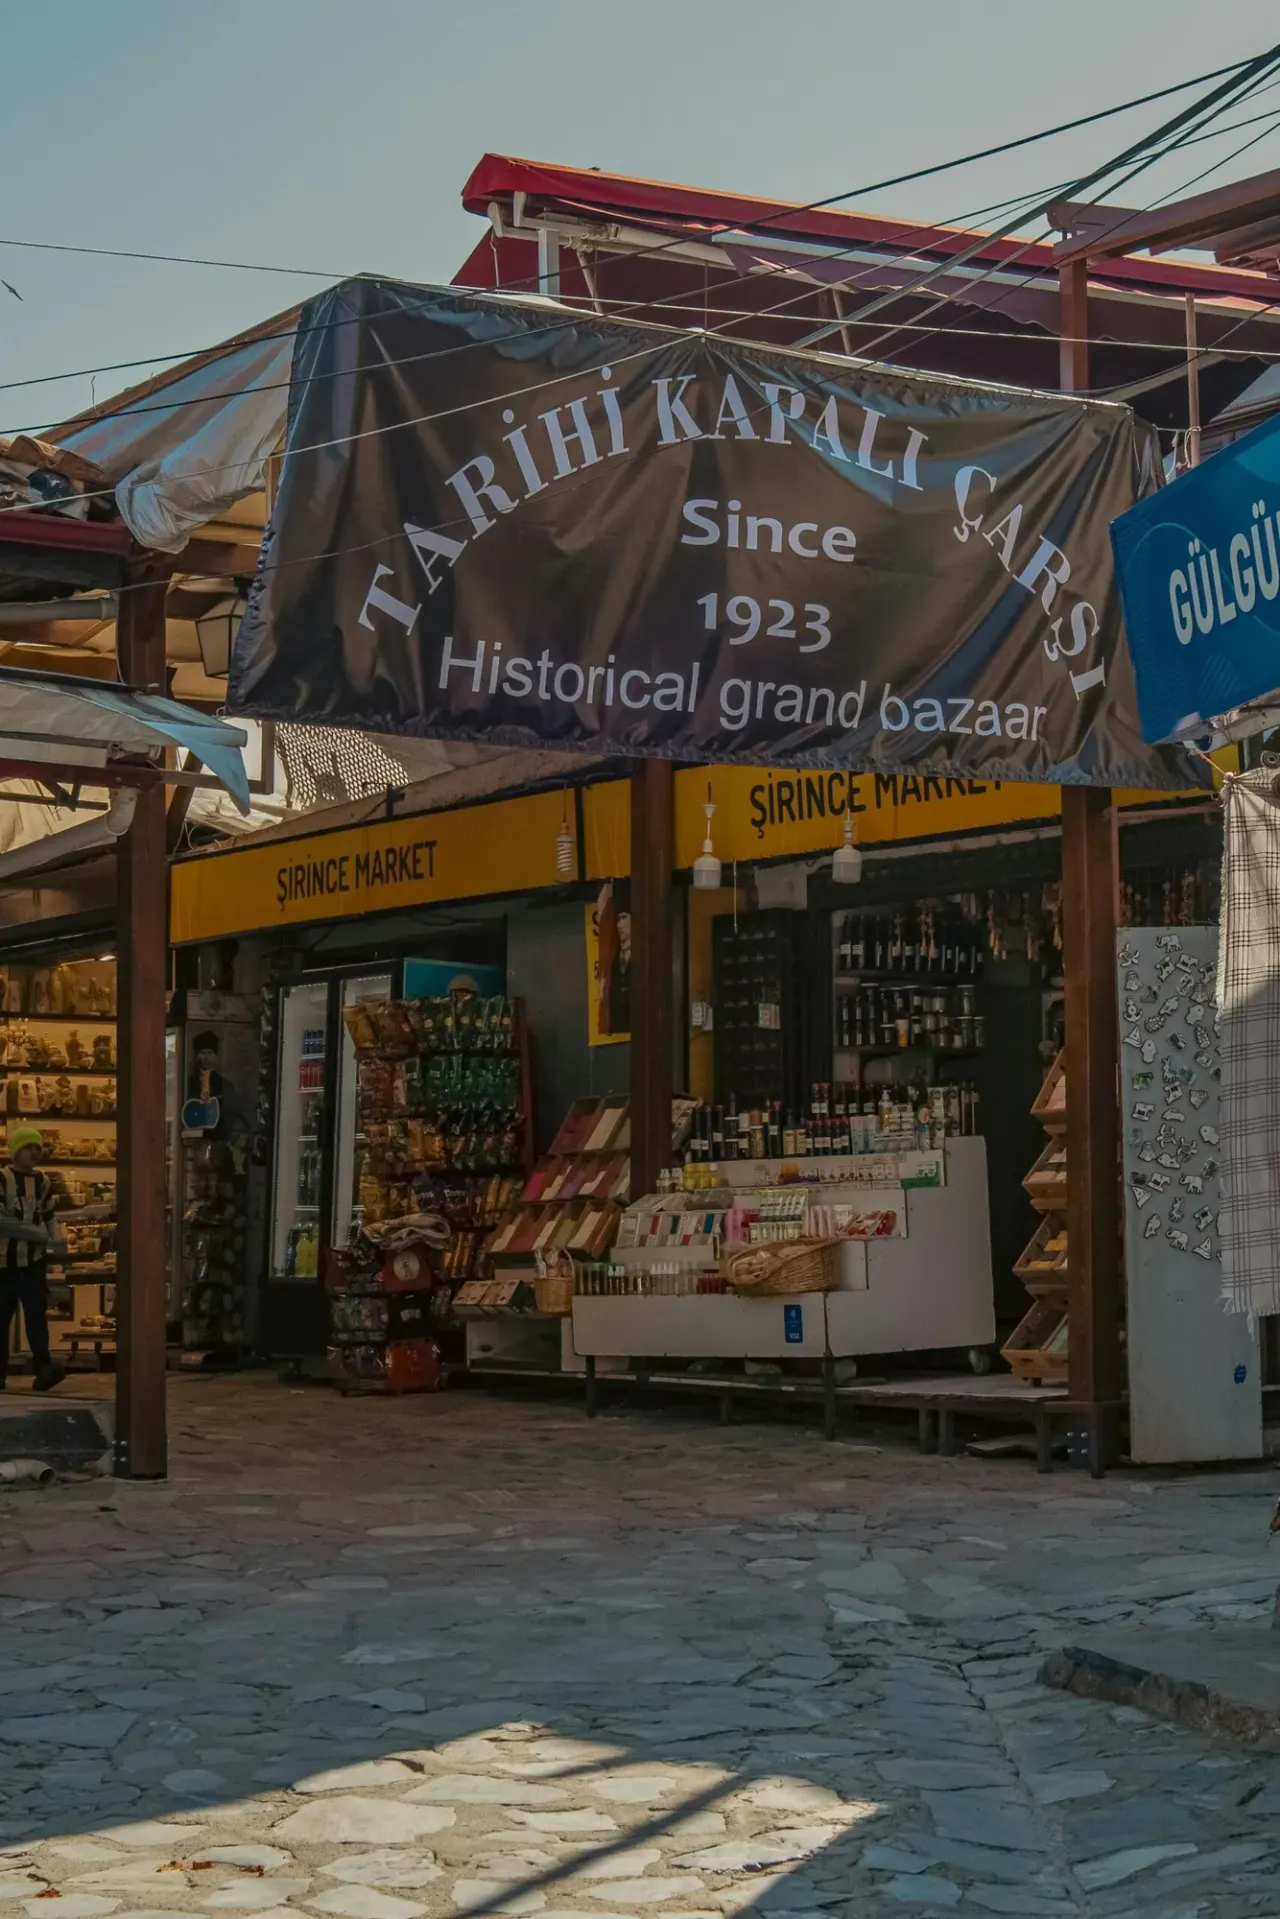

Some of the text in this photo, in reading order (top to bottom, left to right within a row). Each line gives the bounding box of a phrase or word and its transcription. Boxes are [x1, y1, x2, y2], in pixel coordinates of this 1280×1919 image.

[358, 366, 1107, 701] TARİHİ KAPALI ÇARŞI
[681, 498, 857, 562] Since
[1169, 499, 1280, 645] GÜLGÜ
[697, 592, 832, 653] 1923
[438, 636, 1048, 741] Historical grand bazaar
[750, 769, 867, 839] ŞİRİNCE
[276, 840, 438, 912] ŞİRİNCE MARKET
